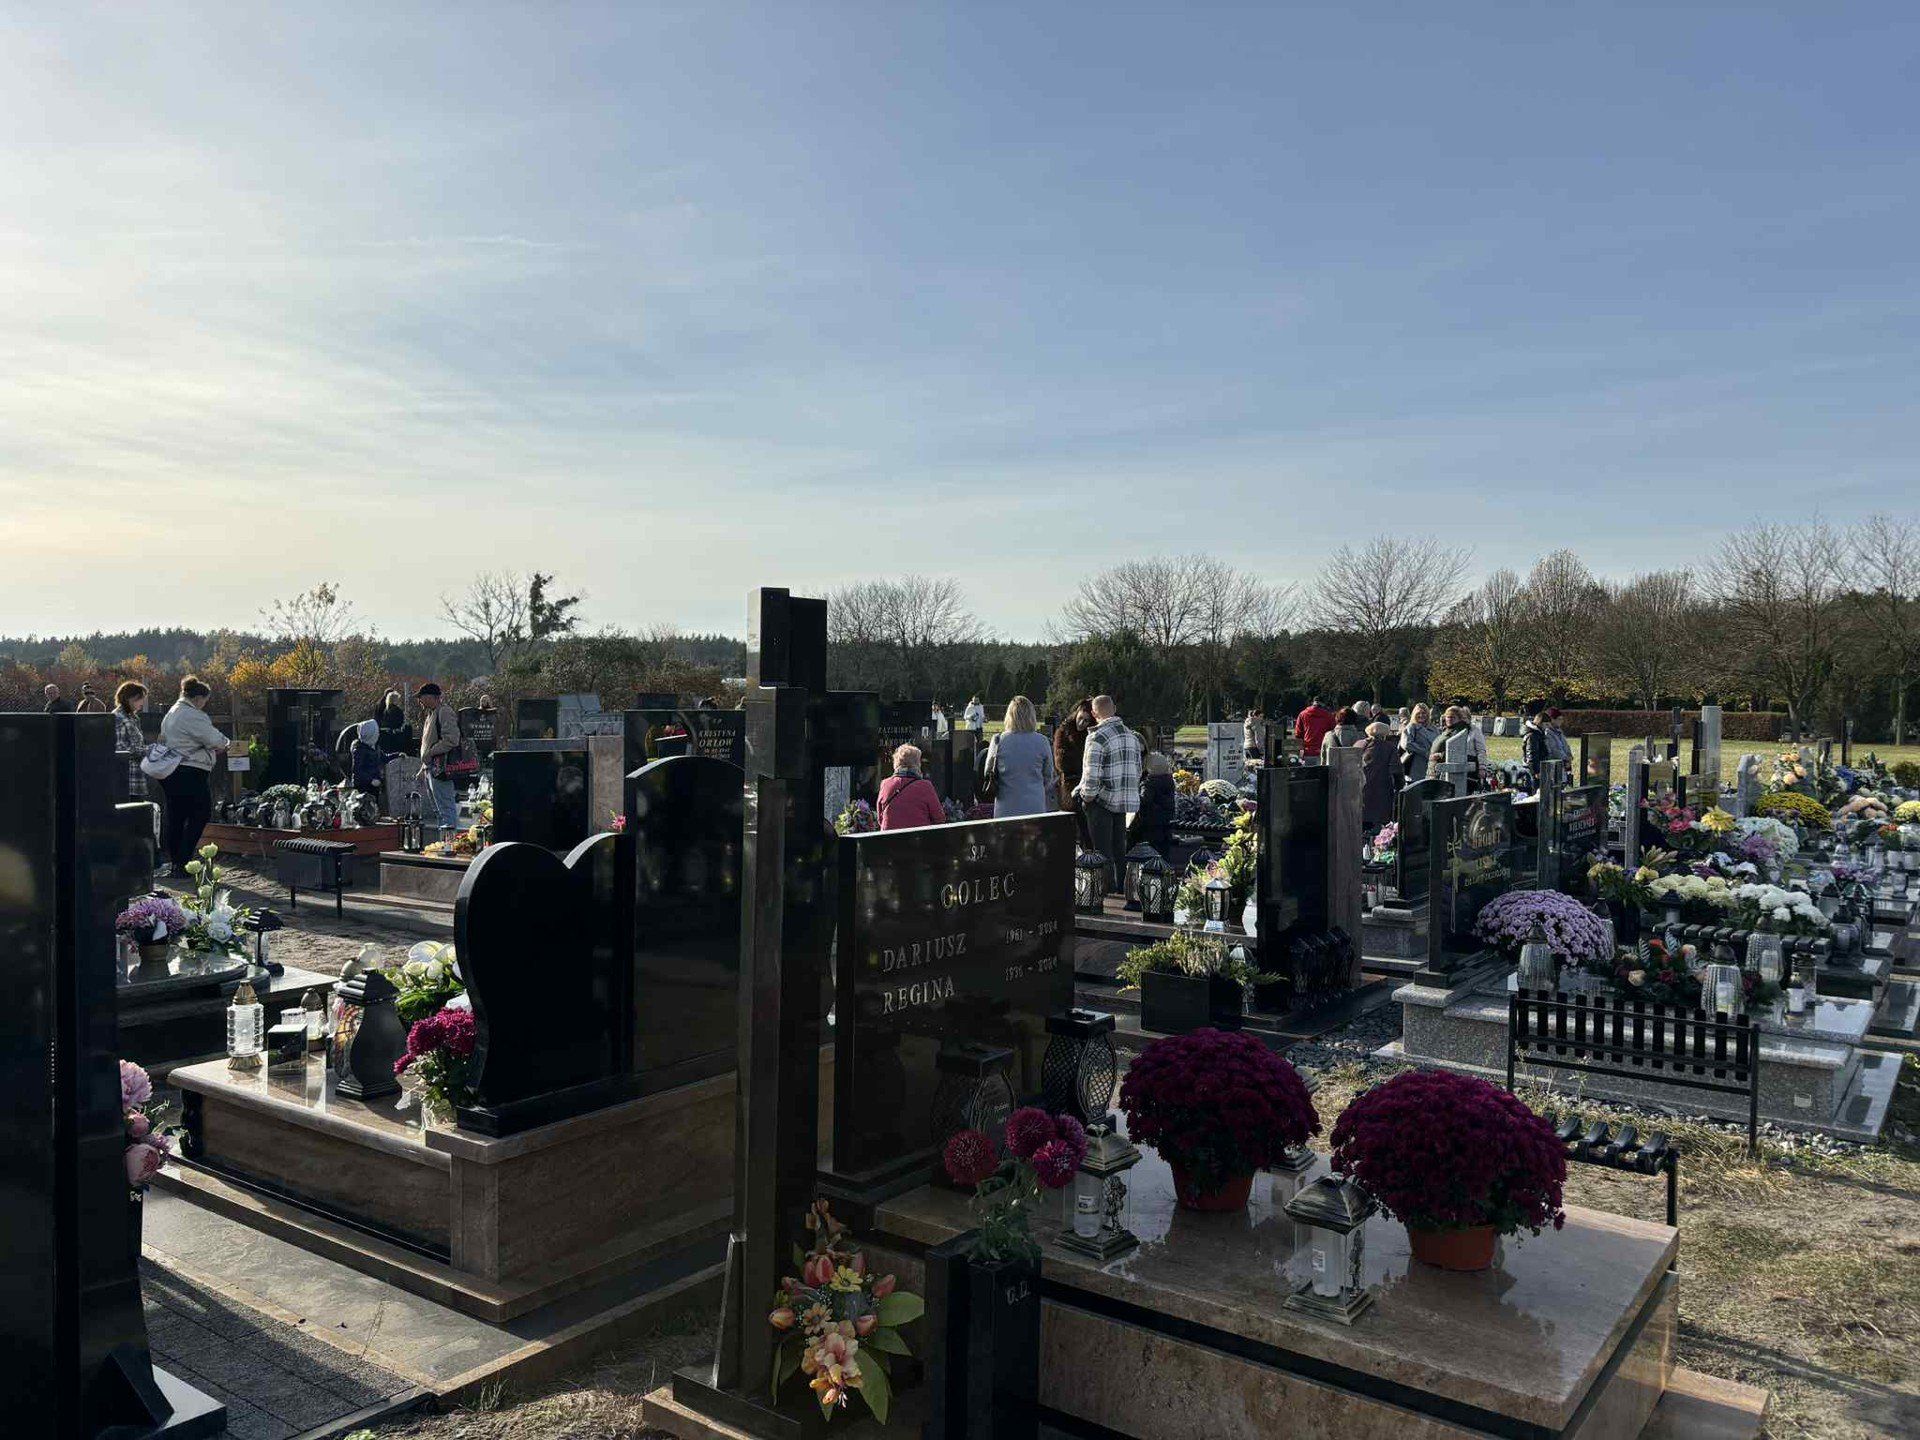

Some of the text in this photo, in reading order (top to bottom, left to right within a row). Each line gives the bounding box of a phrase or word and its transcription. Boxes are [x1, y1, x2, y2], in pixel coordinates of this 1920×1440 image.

[940, 872, 1017, 910] GOLEC
[882, 933, 968, 973] DARIUSZ
[882, 974, 957, 1015] REGINA
